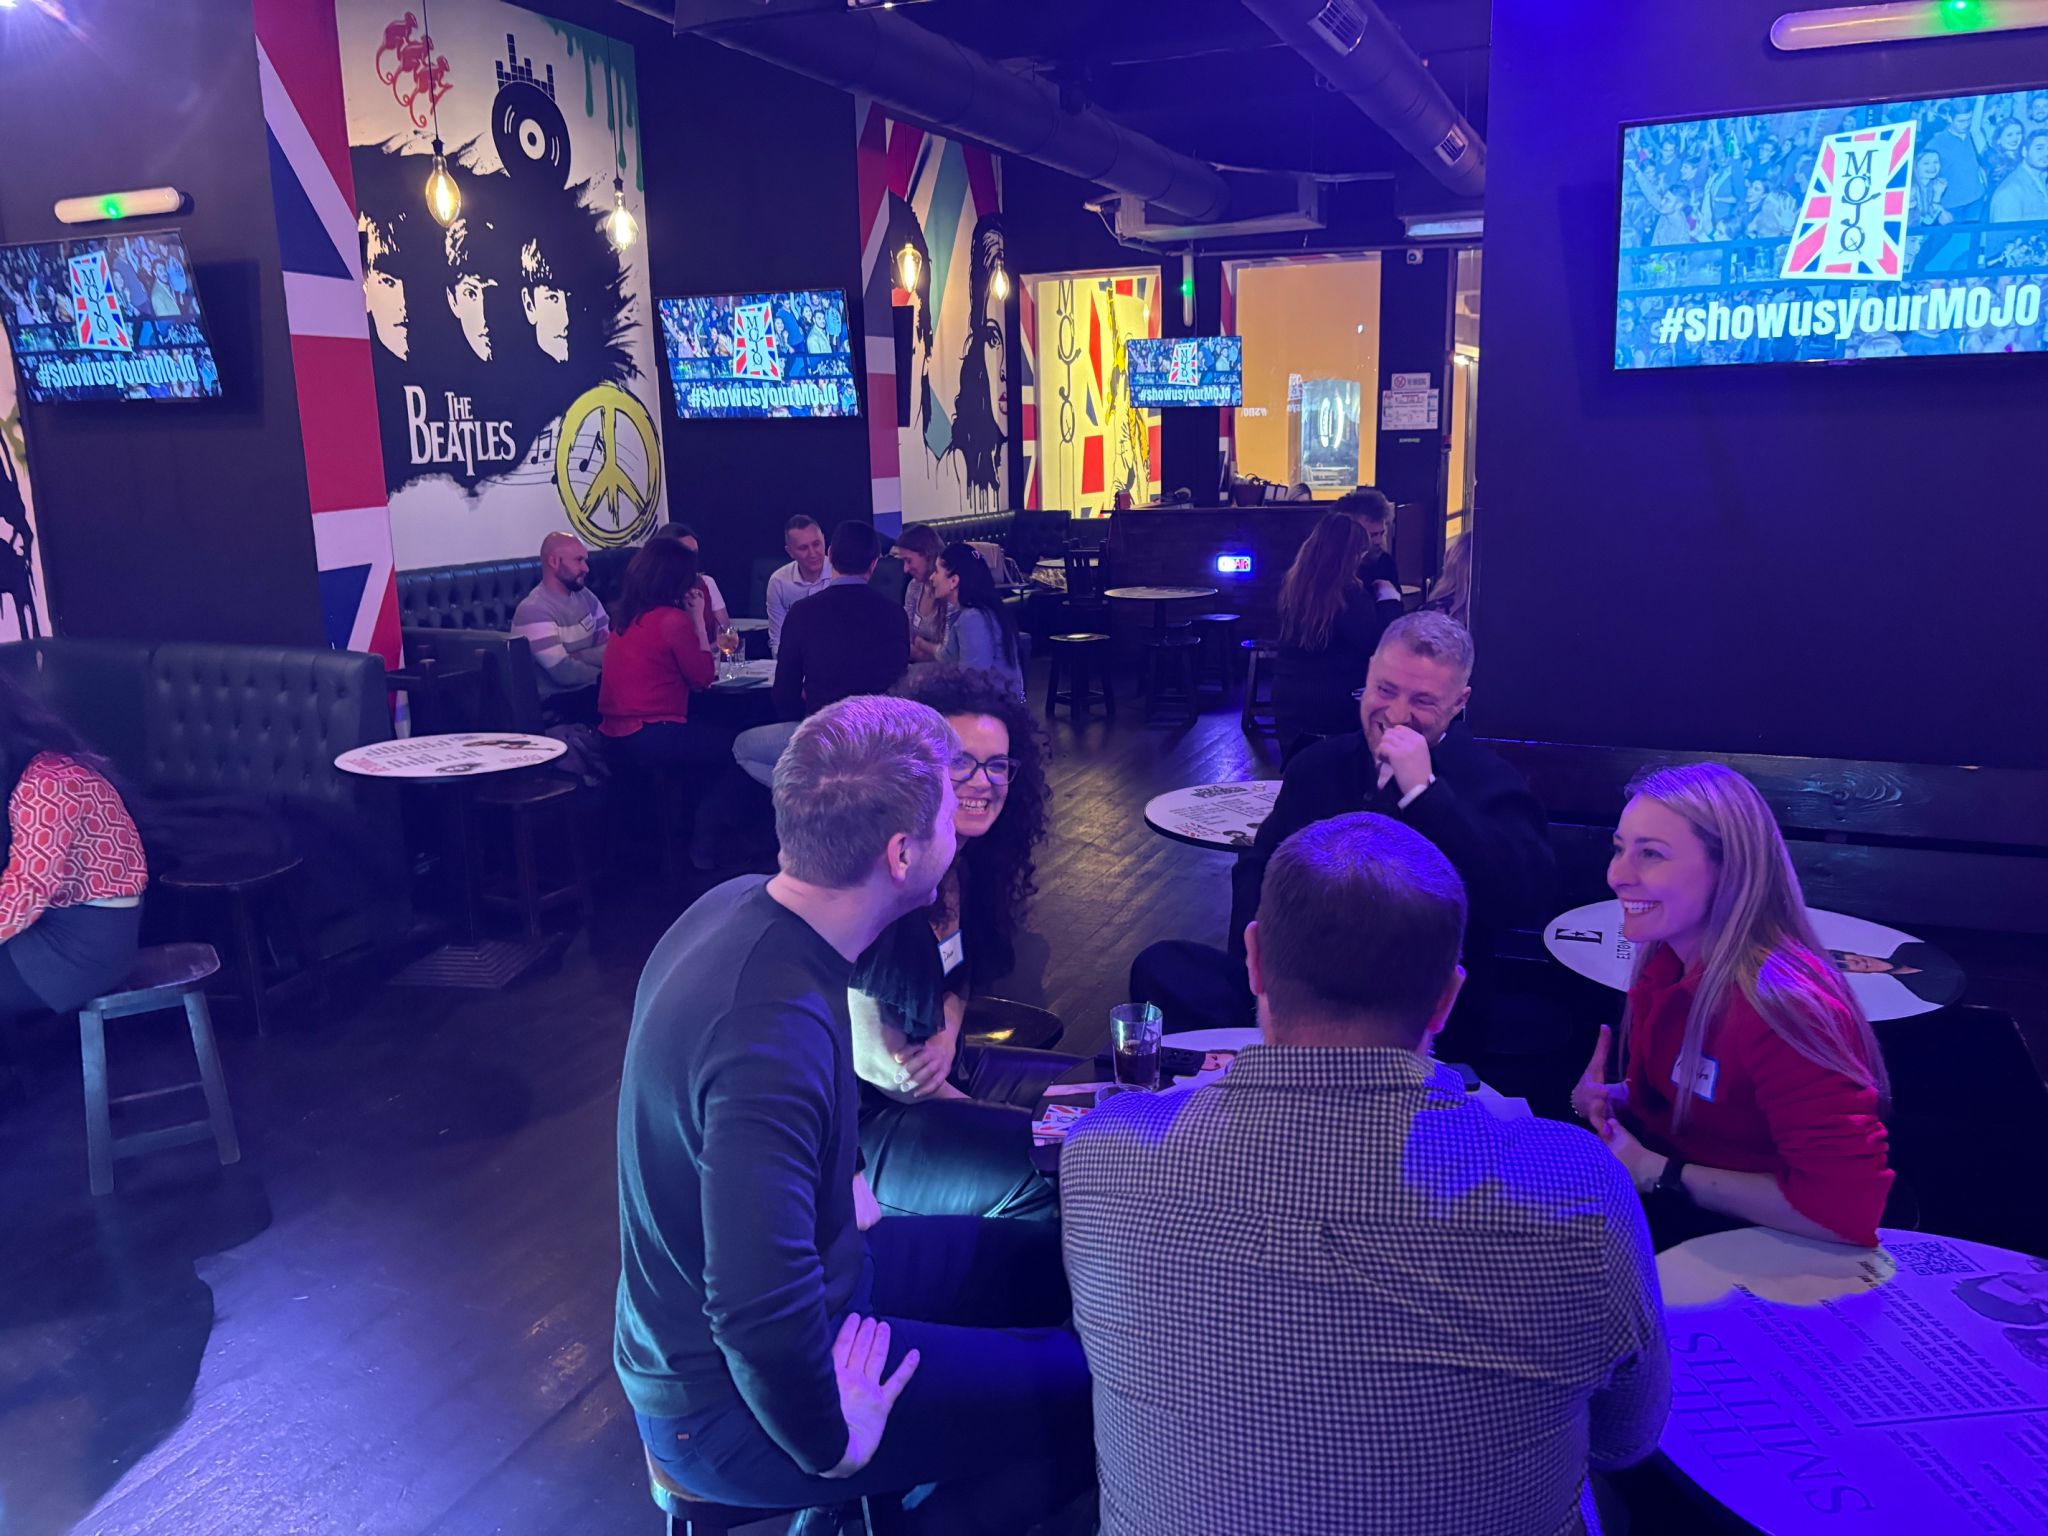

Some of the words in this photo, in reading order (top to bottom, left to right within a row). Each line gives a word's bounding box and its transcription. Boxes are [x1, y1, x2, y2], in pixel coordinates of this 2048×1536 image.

[1838, 149, 1881, 255] MOJO
[81, 269, 110, 335] MOJO
[1659, 284, 2041, 345] #showusyourMOJO
[745, 315, 766, 367] MOJO
[37, 355, 199, 389] #showusyourMOJO
[689, 383, 839, 409] #showusyourMOJO
[1140, 387, 1231, 401] #showusyourMOJO
[403, 385, 516, 477] BEATLES
[444, 391, 474, 421] THE
